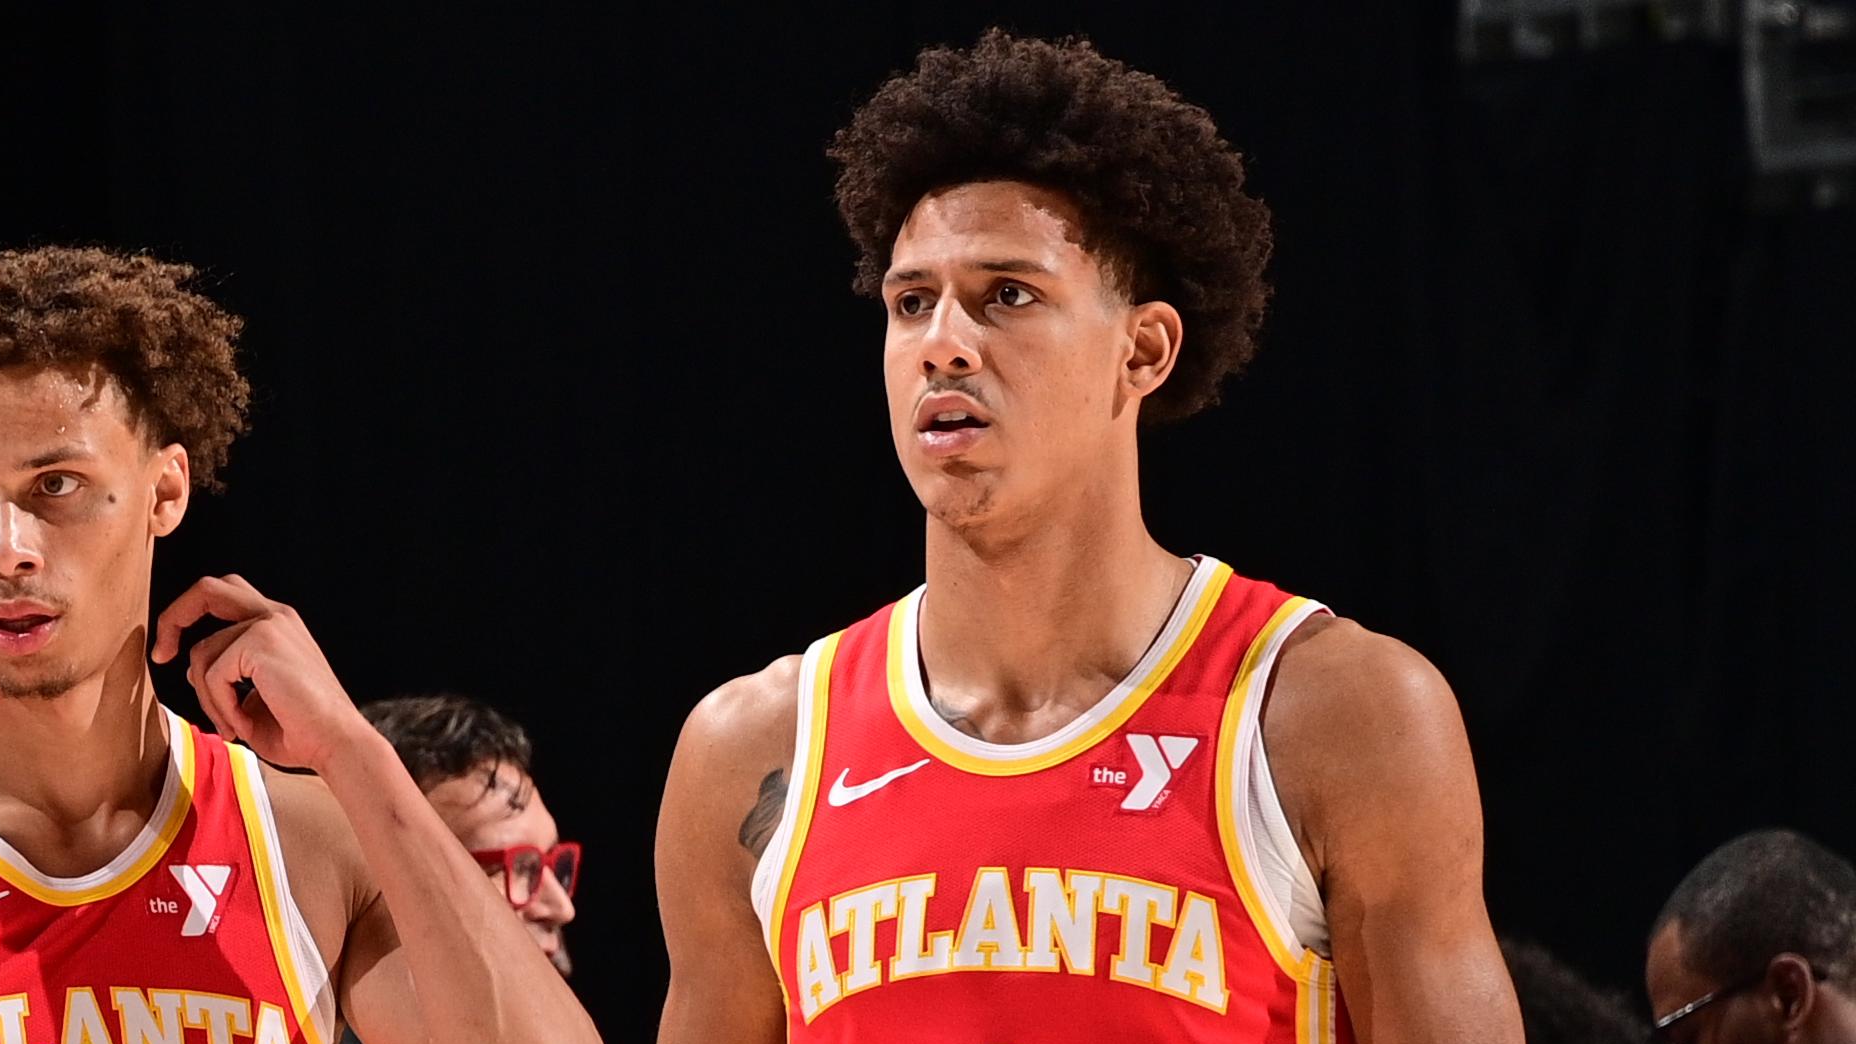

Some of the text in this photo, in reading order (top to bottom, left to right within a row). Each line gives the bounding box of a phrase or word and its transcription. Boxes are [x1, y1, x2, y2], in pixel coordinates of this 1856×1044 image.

[1093, 767, 1127, 785] the
[149, 897, 179, 914] the
[796, 866, 1231, 1027] ATLANTA
